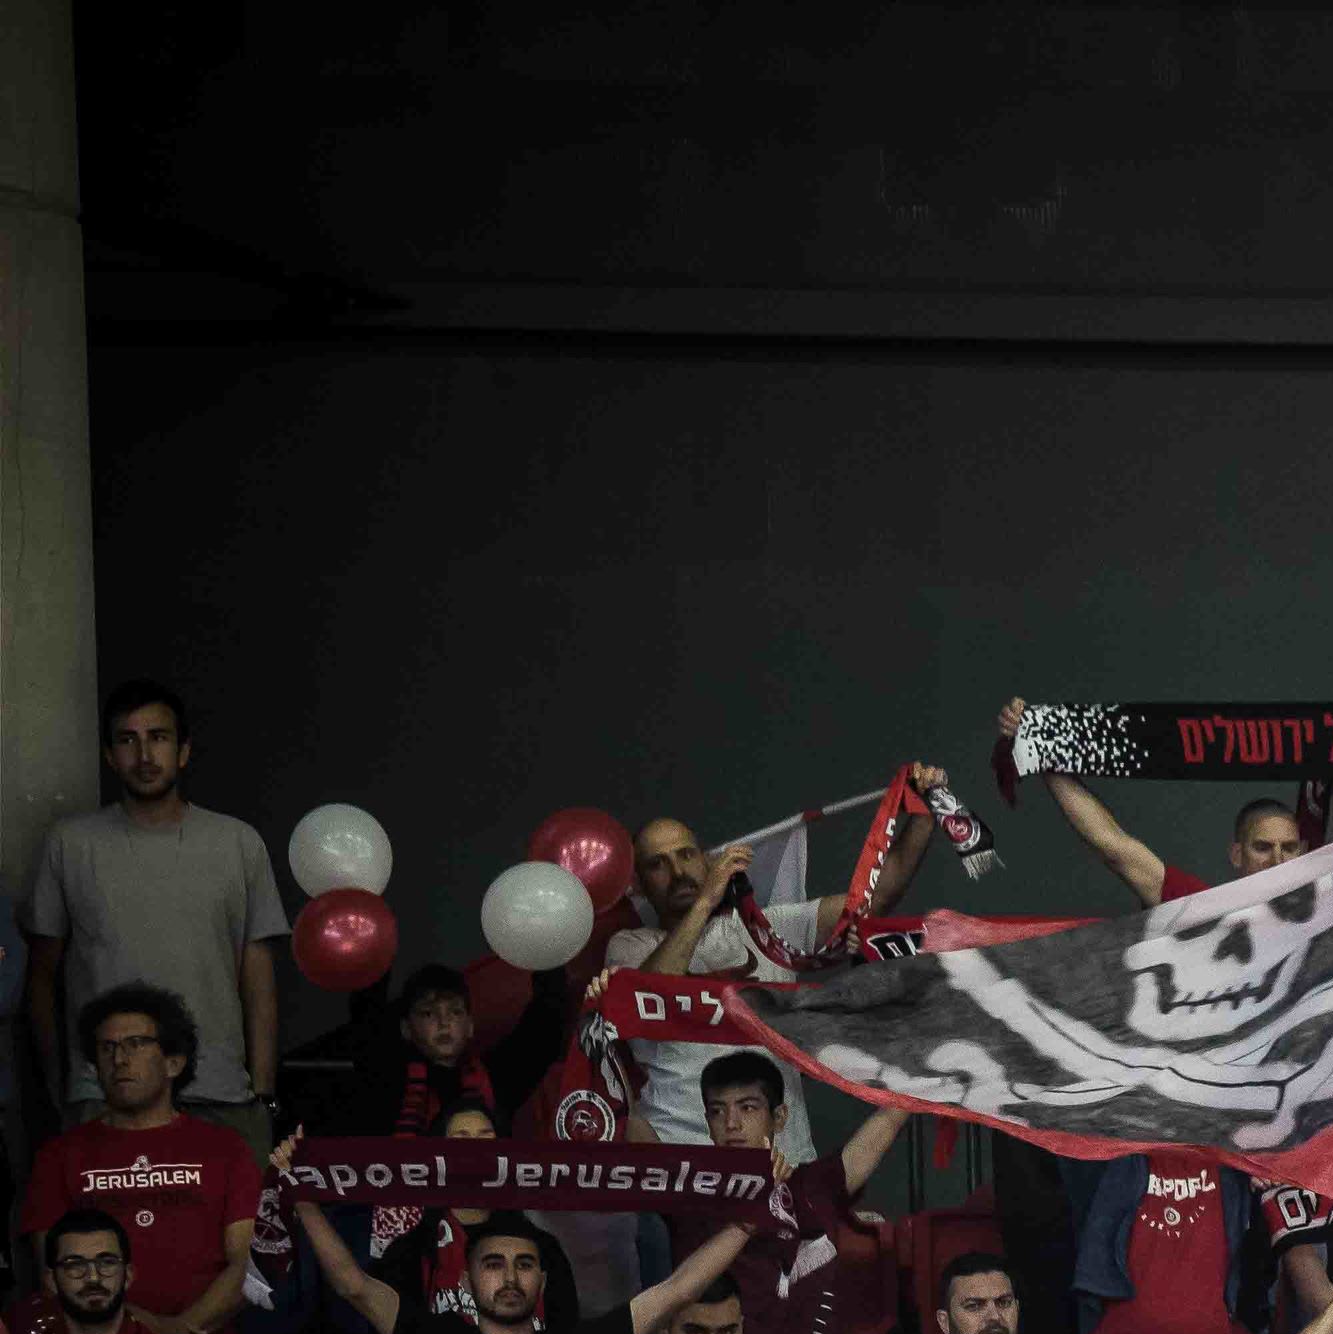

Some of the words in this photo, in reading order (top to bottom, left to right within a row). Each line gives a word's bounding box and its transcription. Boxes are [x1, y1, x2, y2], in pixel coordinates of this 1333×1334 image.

[1178, 715, 1316, 765] ירושלים
[82, 1168, 202, 1192] JERUSALEM
[484, 1155, 767, 1201] Jerusalem
